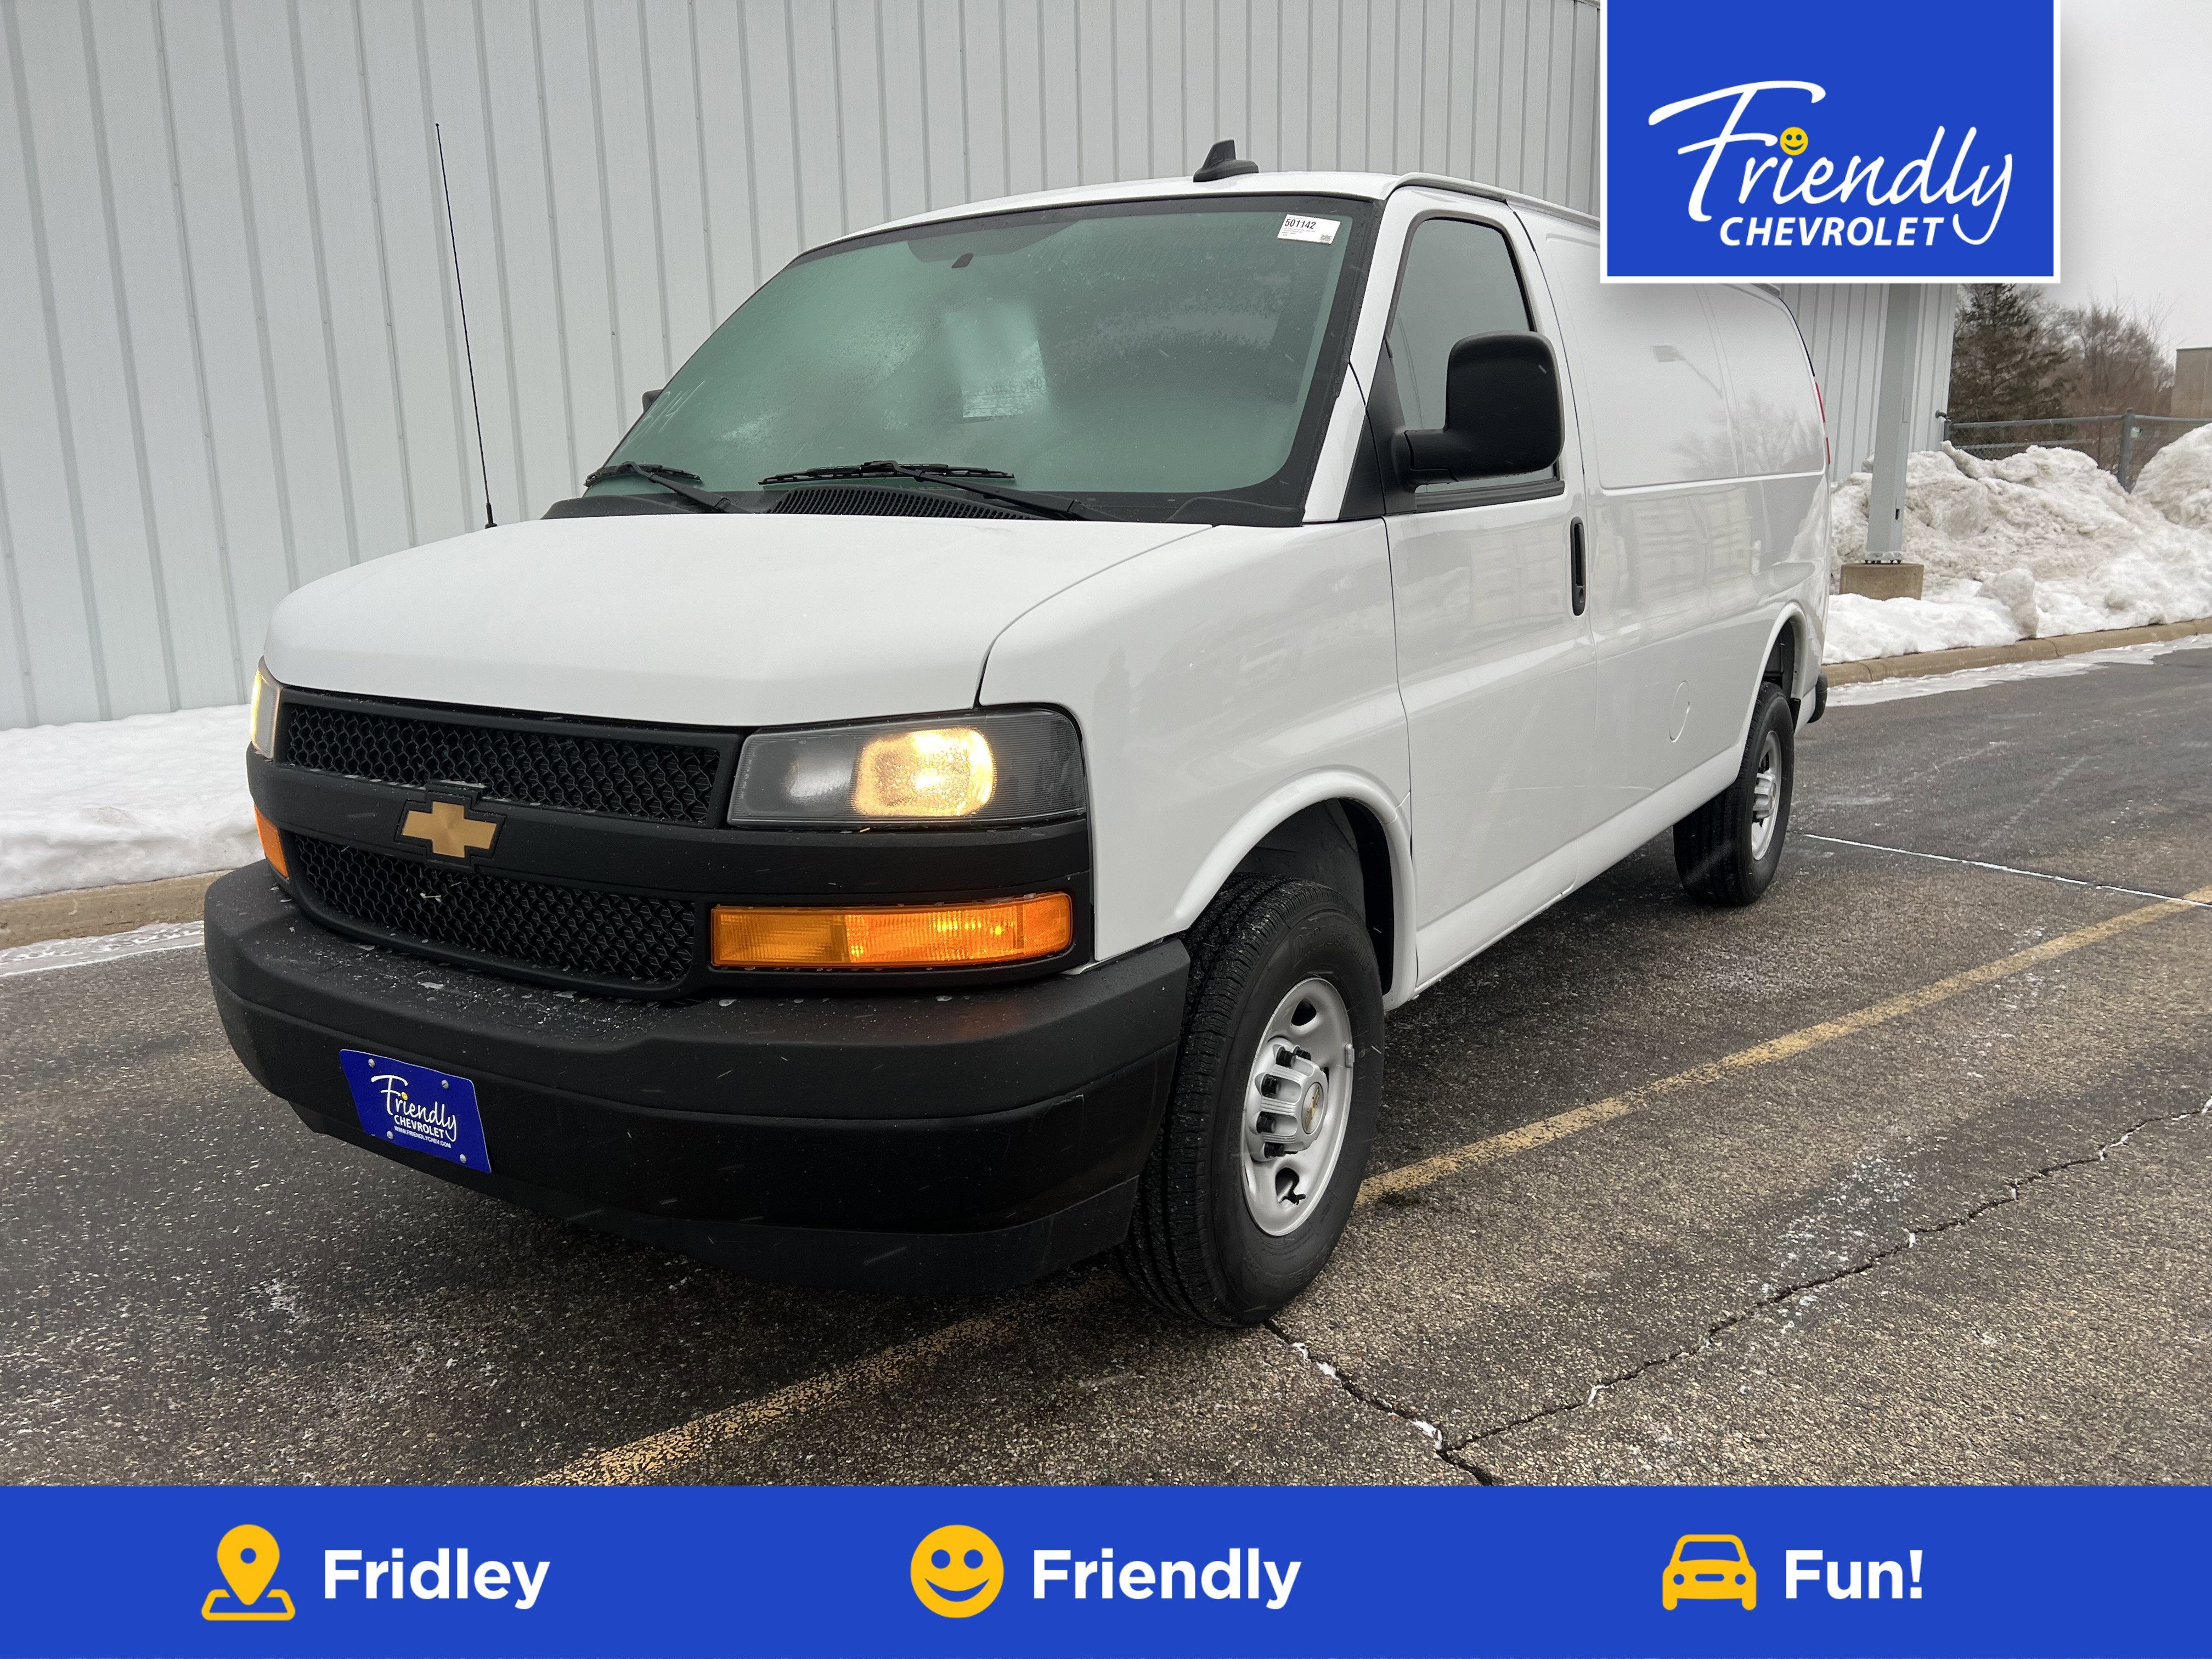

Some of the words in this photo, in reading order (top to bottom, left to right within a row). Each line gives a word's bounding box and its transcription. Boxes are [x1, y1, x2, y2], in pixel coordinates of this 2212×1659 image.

[1285, 218, 1316, 229] 501142
[370, 1075, 456, 1142] Friendly
[394, 1115, 444, 1138] CHEVROLET
